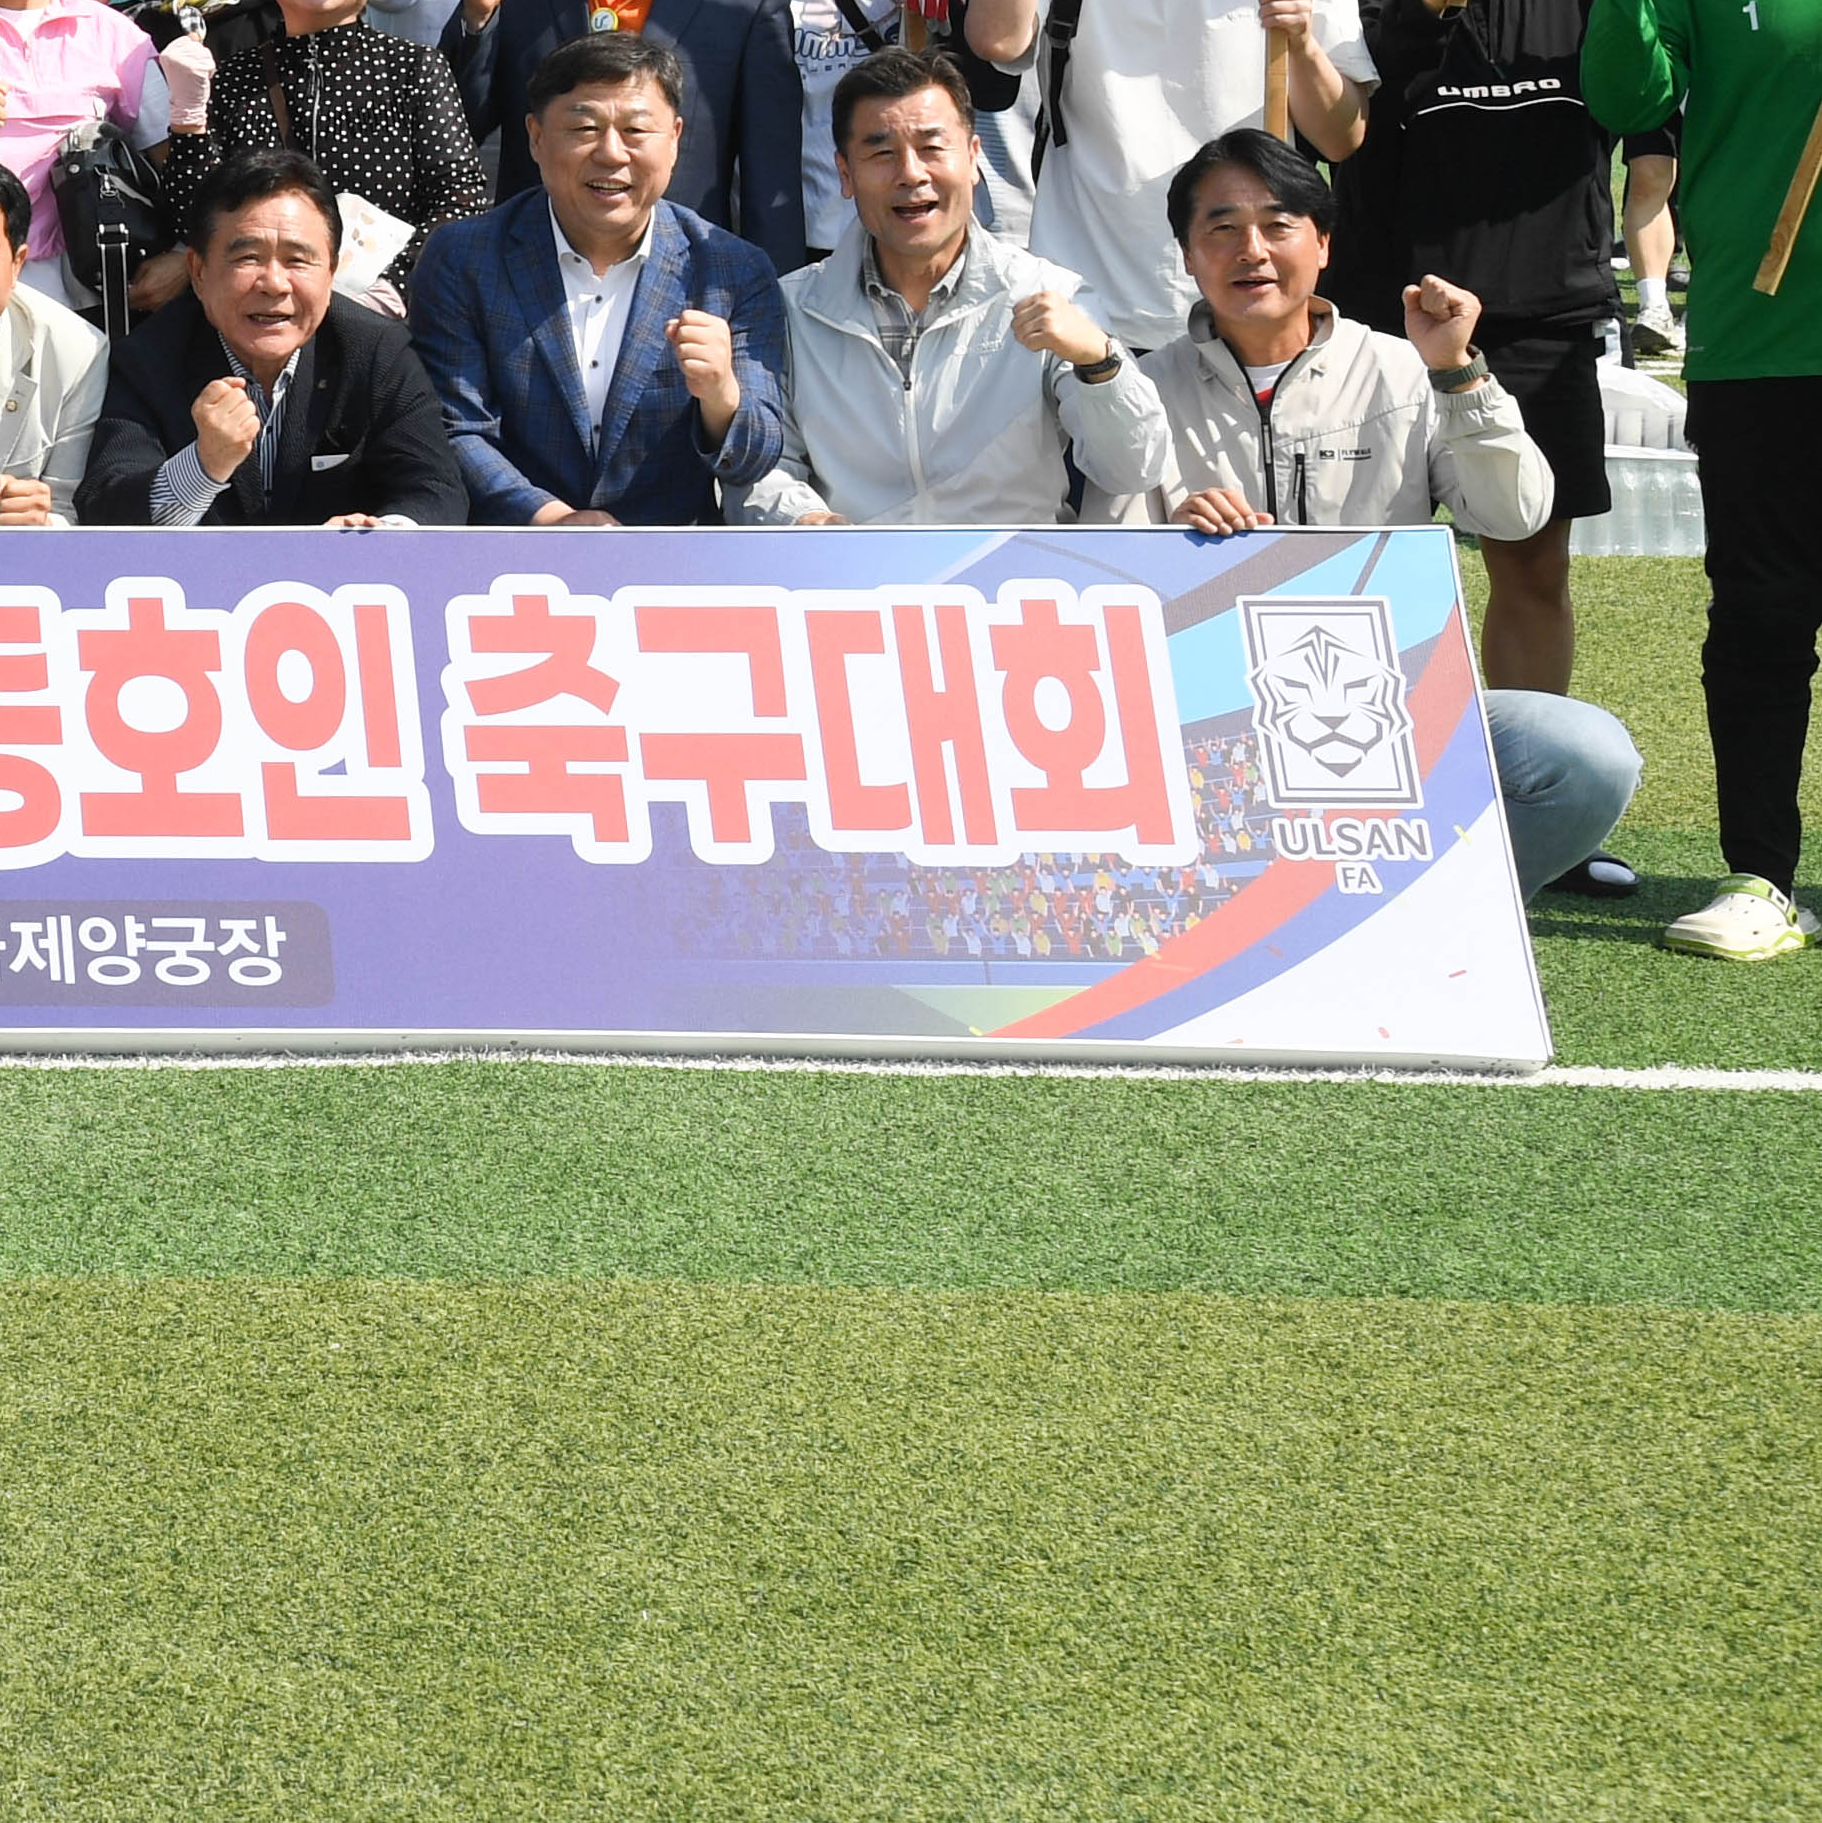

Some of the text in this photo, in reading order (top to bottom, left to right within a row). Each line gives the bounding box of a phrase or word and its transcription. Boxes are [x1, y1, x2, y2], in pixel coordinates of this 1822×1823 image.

[1742, 0, 1759, 30] 1
[1437, 78, 1561, 98] UMBRO
[466, 596, 1175, 848] 축구대회
[1278, 822, 1428, 856] ULSAN
[1341, 867, 1376, 889] FA
